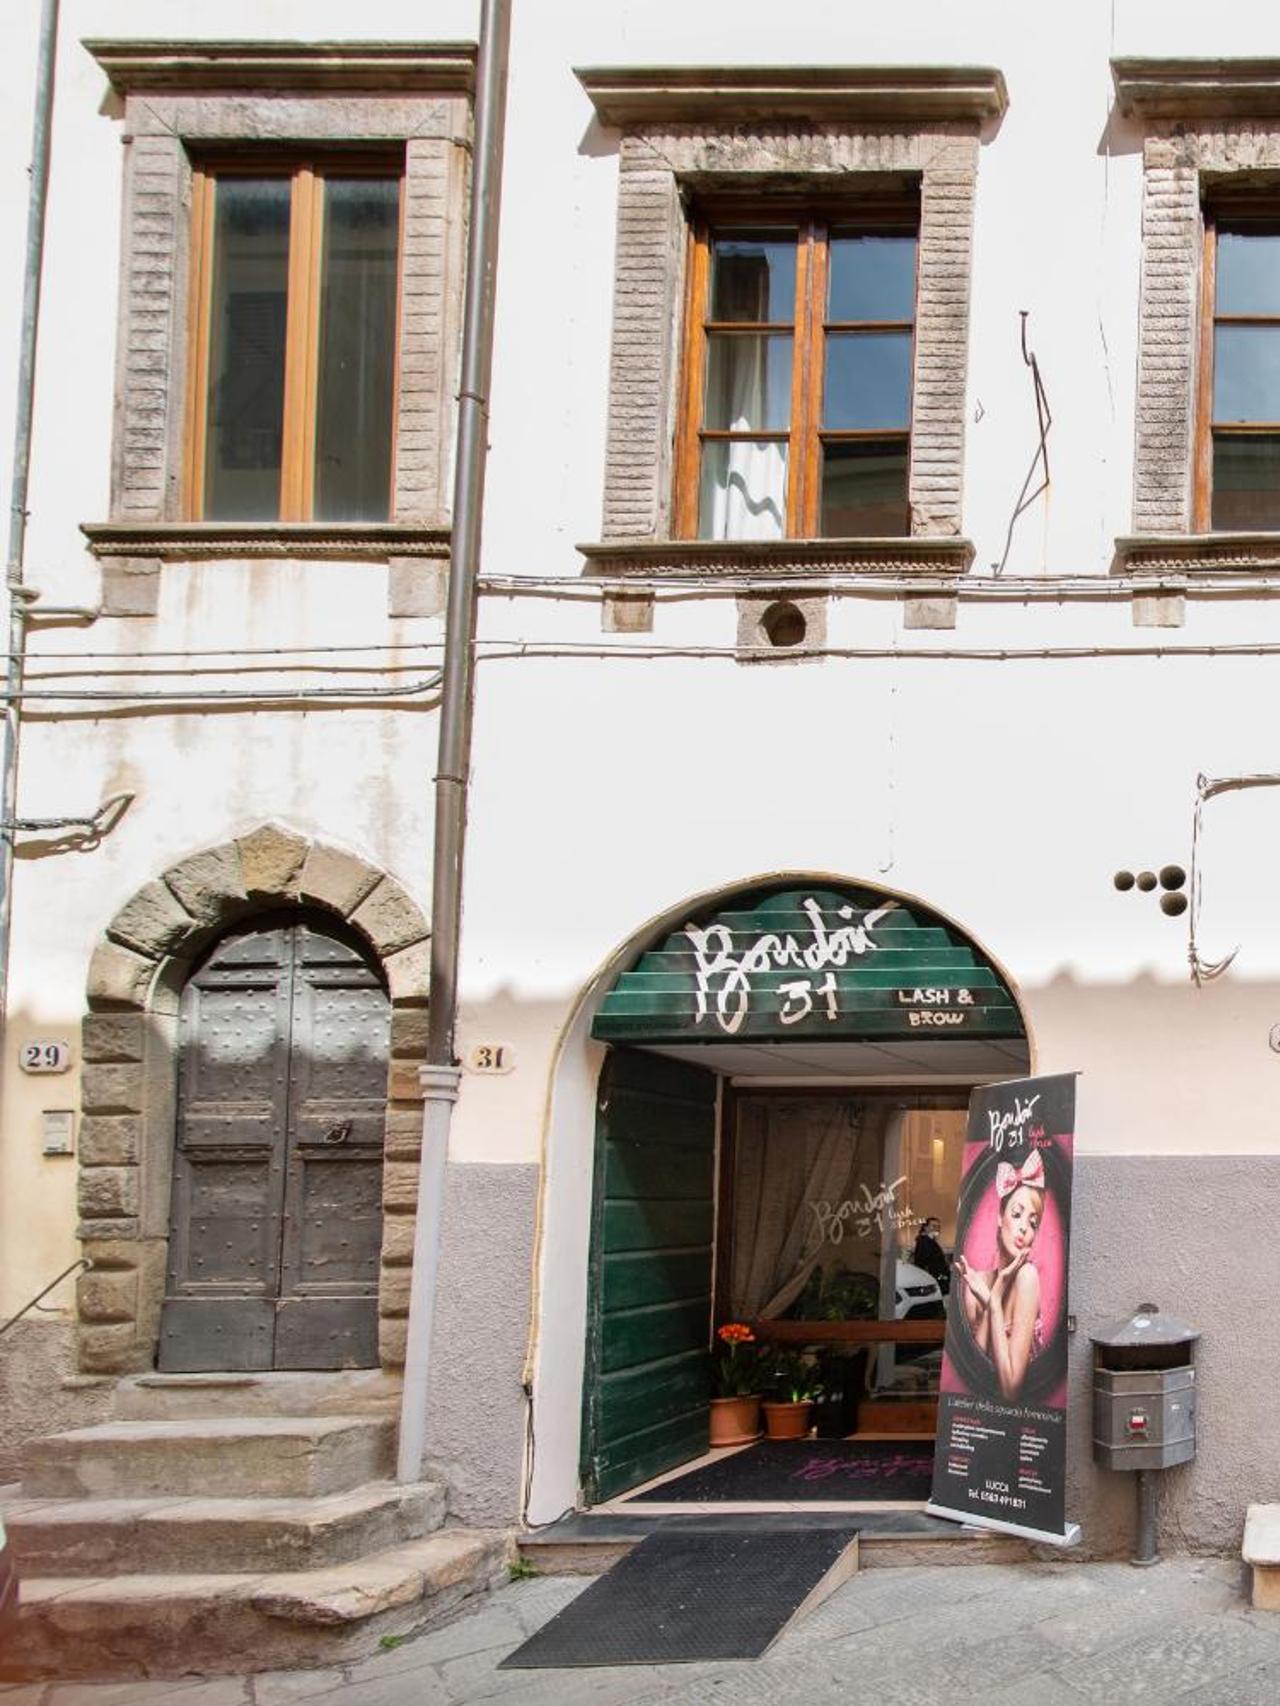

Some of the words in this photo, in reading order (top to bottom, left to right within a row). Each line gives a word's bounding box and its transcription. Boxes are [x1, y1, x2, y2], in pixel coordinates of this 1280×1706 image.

[684, 897, 901, 1035] Boudoir
[776, 971, 839, 1025] 31
[898, 988, 950, 1004] LASH
[957, 988, 975, 1005] &
[908, 1011, 965, 1027] BROW
[26, 1045, 60, 1068] 29
[477, 1046, 504, 1069] 31
[1007, 1126, 1024, 1148] 31
[809, 1175, 907, 1245] Boudoir
[855, 1212, 884, 1237] 31
